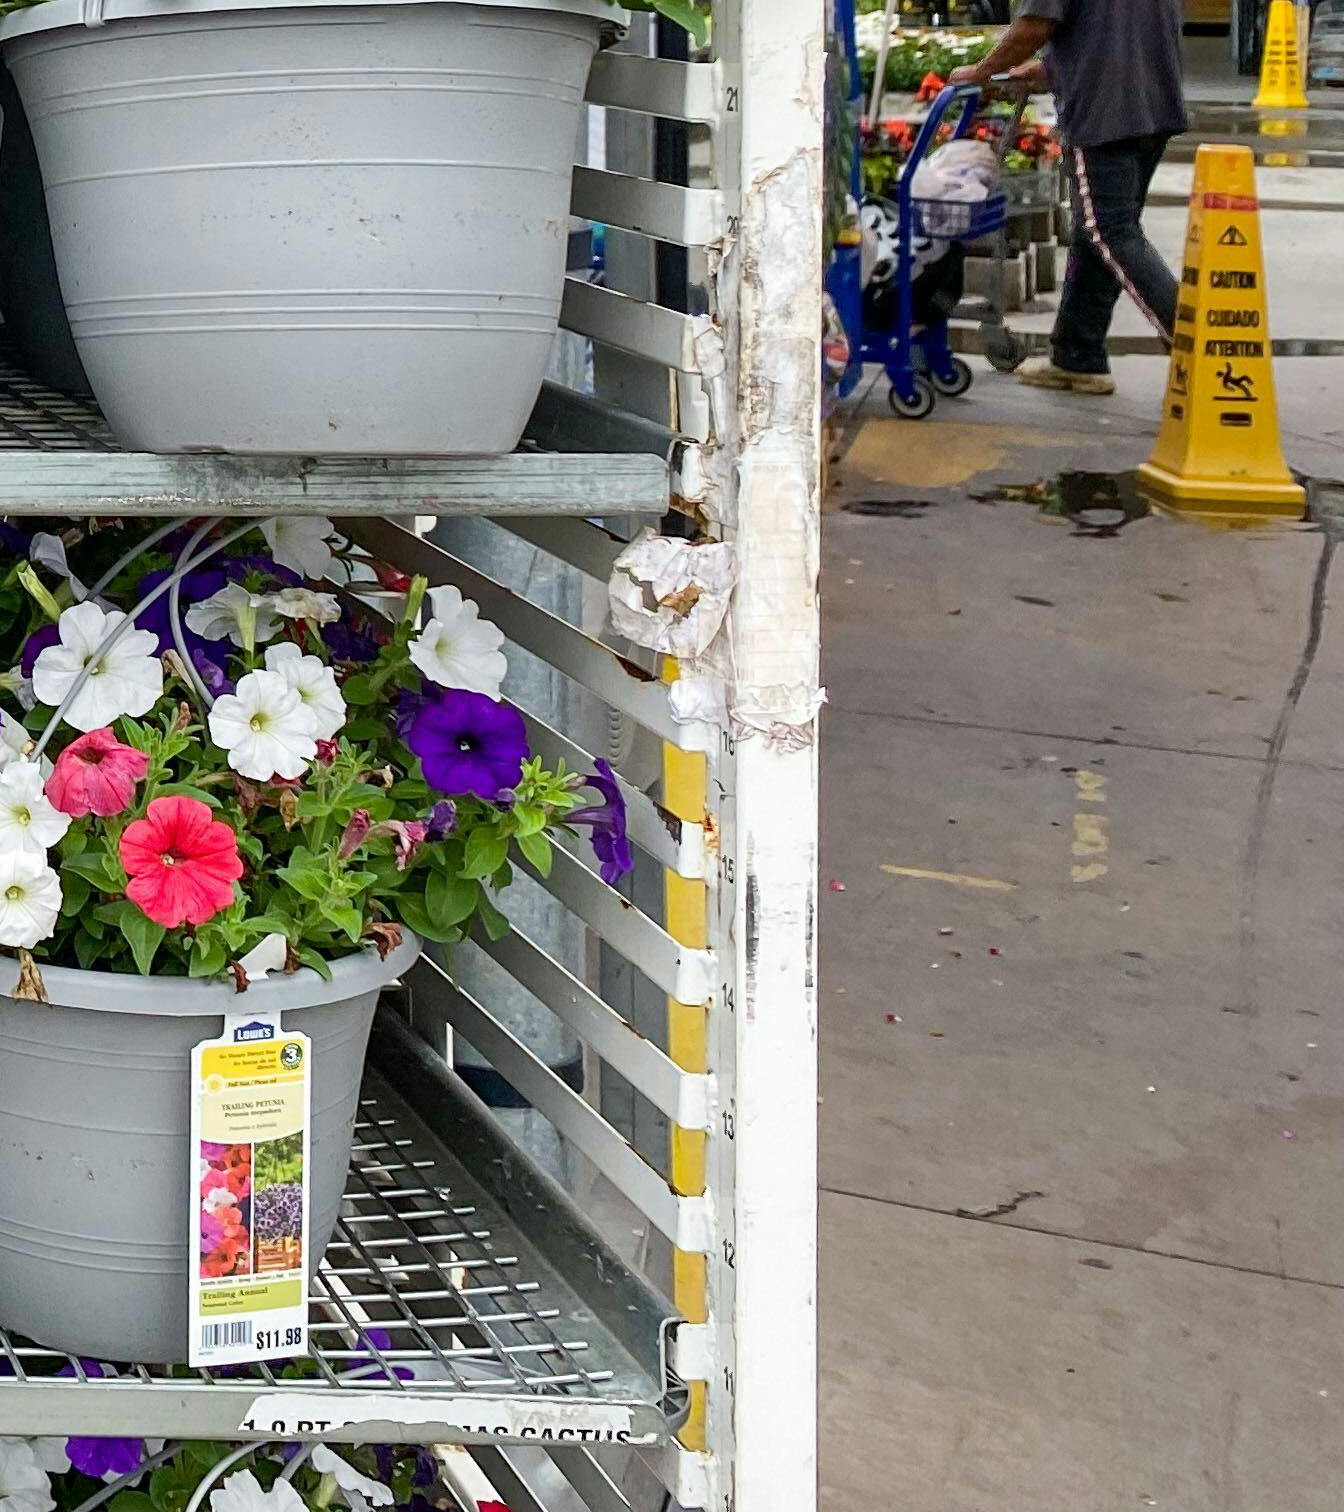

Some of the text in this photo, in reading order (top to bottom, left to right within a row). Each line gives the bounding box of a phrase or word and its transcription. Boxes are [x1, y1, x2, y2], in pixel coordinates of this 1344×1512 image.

[726, 87, 738, 112] 21
[1210, 271, 1256, 289] CAUTION
[1206, 310, 1260, 328] CUIDADO
[1205, 340, 1264, 357] ATTENTION
[721, 855, 734, 884] 15
[722, 982, 734, 1012] 14
[238, 1027, 271, 1040] LOWE'S
[221, 1099, 285, 1111] TRAILING PETUNIA
[722, 1111, 734, 1140] 13
[722, 1239, 735, 1269] 12
[202, 1287, 268, 1300] Trailing Annual
[256, 1327, 302, 1351] $11.98
